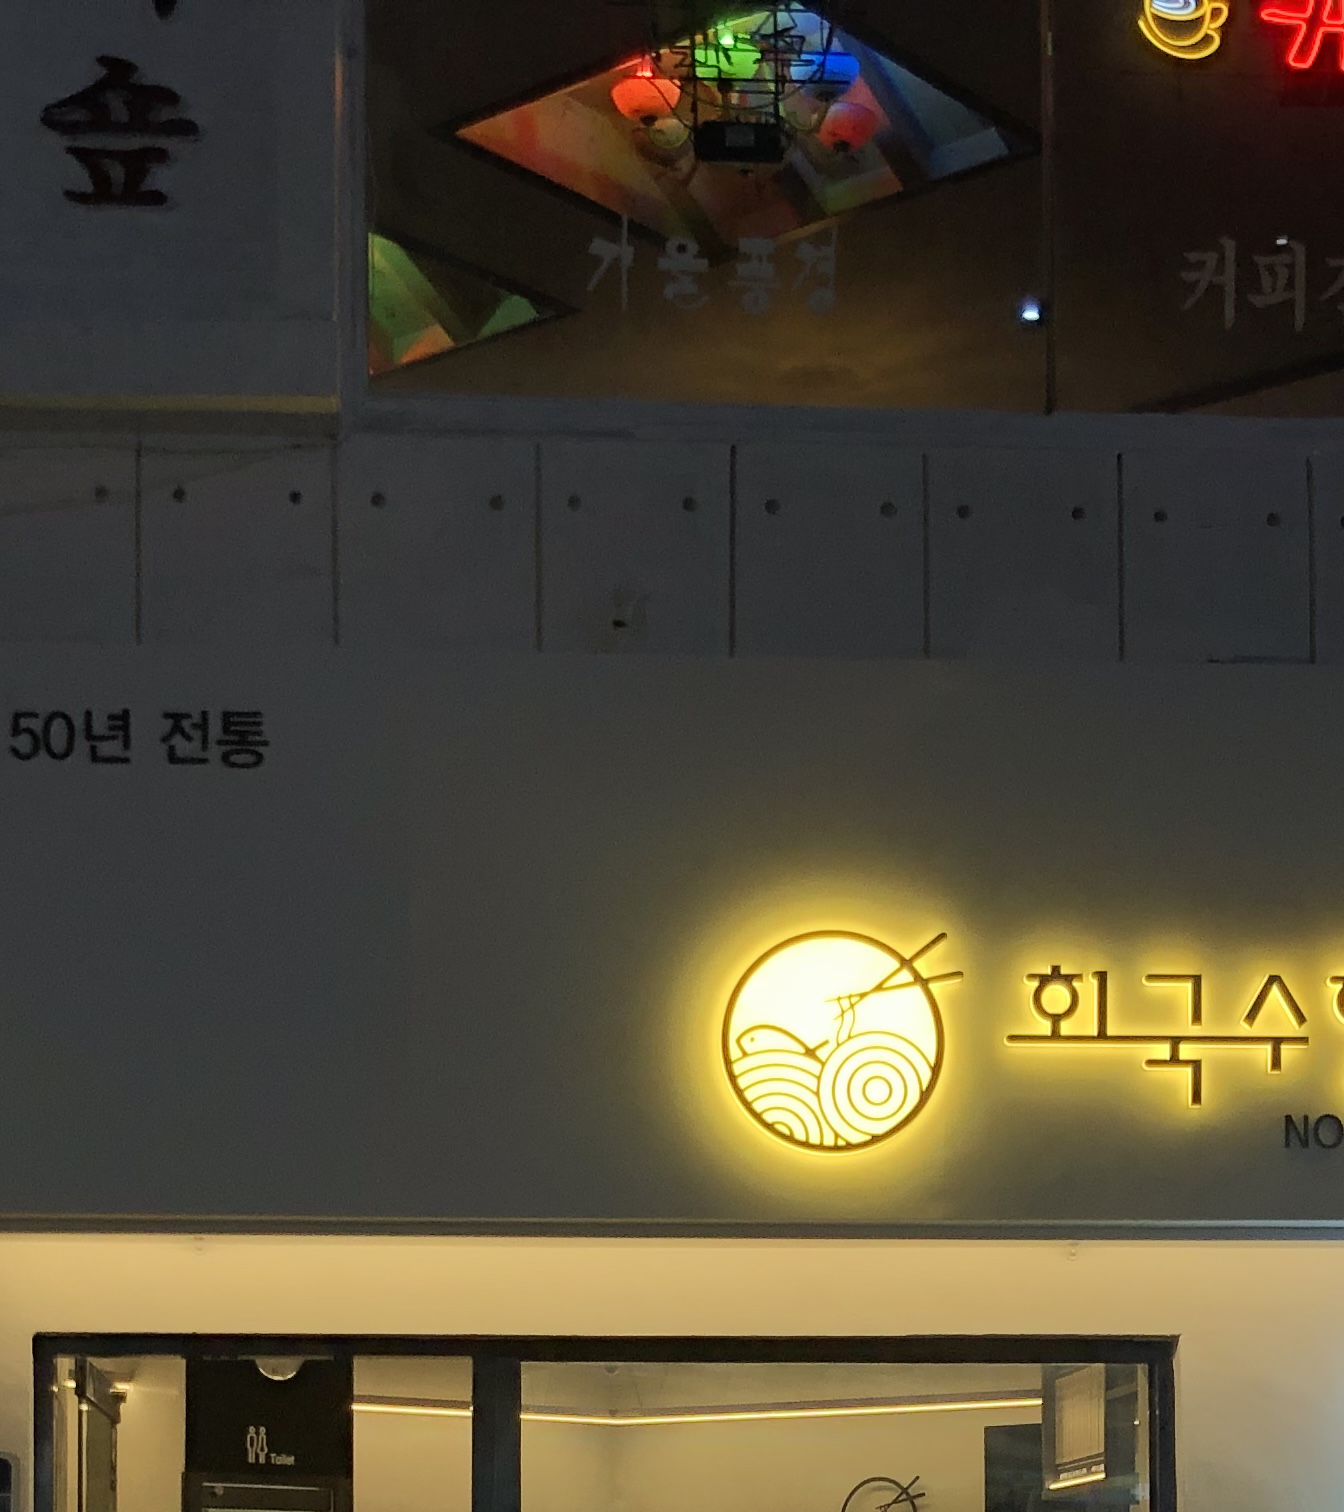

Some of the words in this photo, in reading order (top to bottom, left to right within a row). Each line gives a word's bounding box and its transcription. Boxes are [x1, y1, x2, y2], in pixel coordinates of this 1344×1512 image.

[9, 709, 132, 765] 50년
[159, 709, 270, 769] 전통
[270, 1453, 295, 1465] Toilet
